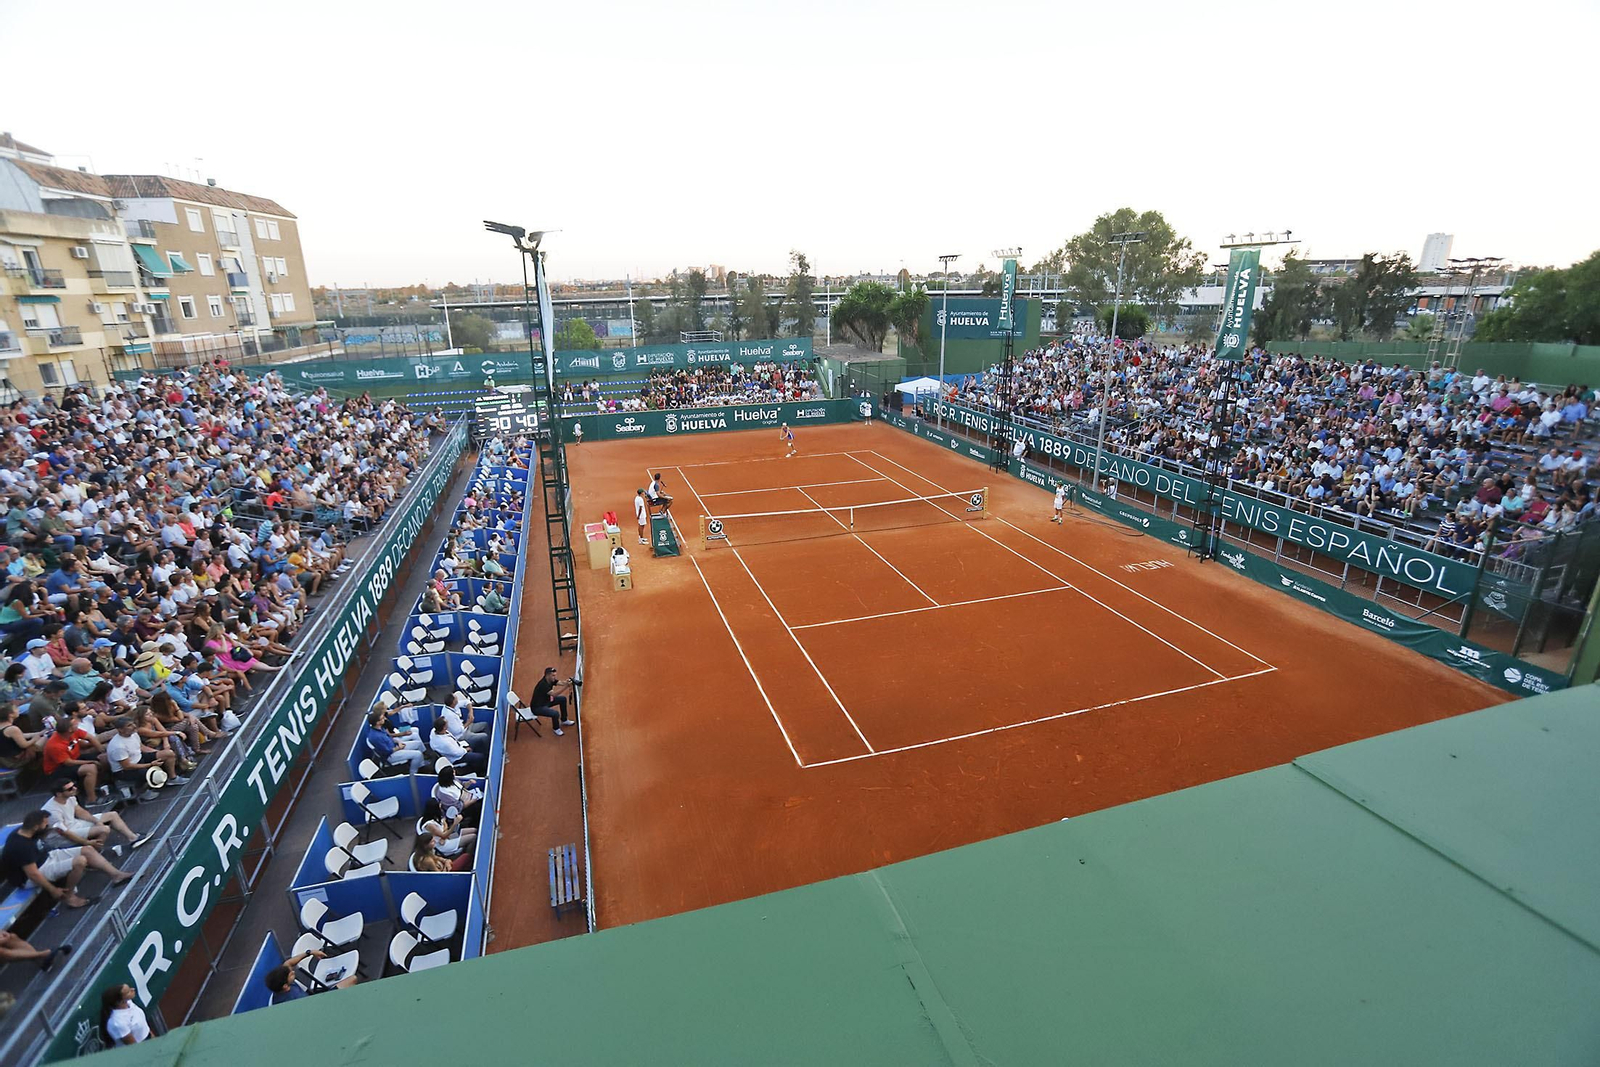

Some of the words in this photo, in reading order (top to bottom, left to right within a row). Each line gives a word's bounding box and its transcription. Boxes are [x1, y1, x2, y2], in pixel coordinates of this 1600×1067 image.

[999, 273, 1012, 320] Huelva
[1233, 268, 1251, 328] HUELVA
[949, 311, 981, 319] Ayuntamiento
[950, 317, 990, 326] HUELVA
[740, 346, 771, 356] Huelva
[698, 353, 731, 362] HUELVA
[680, 412, 717, 420] Ayuntamiento
[734, 407, 778, 421] Huelva
[489, 416, 512, 432] 30
[515, 413, 538, 428] 40
[615, 422, 646, 433] Seabery
[681, 418, 727, 431] HUELVA
[960, 410, 988, 432] TENIS
[1039, 437, 1071, 460] 1889
[1074, 448, 1150, 487] DECANO
[1155, 474, 1196, 505] DEL
[1287, 517, 1457, 595] ESPAÑOL
[1362, 608, 1395, 628] Barceló
[1523, 678, 1535, 686] DEL
[1535, 682, 1550, 690] REY
[1525, 673, 1542, 683] COPA
[1521, 682, 1531, 690] DE
[127, 813, 250, 1008] R.C.R.
[246, 684, 319, 805] TENIS
[314, 595, 373, 700] HUELVA
[368, 555, 394, 606] 1889
[391, 505, 425, 569] DECANO
